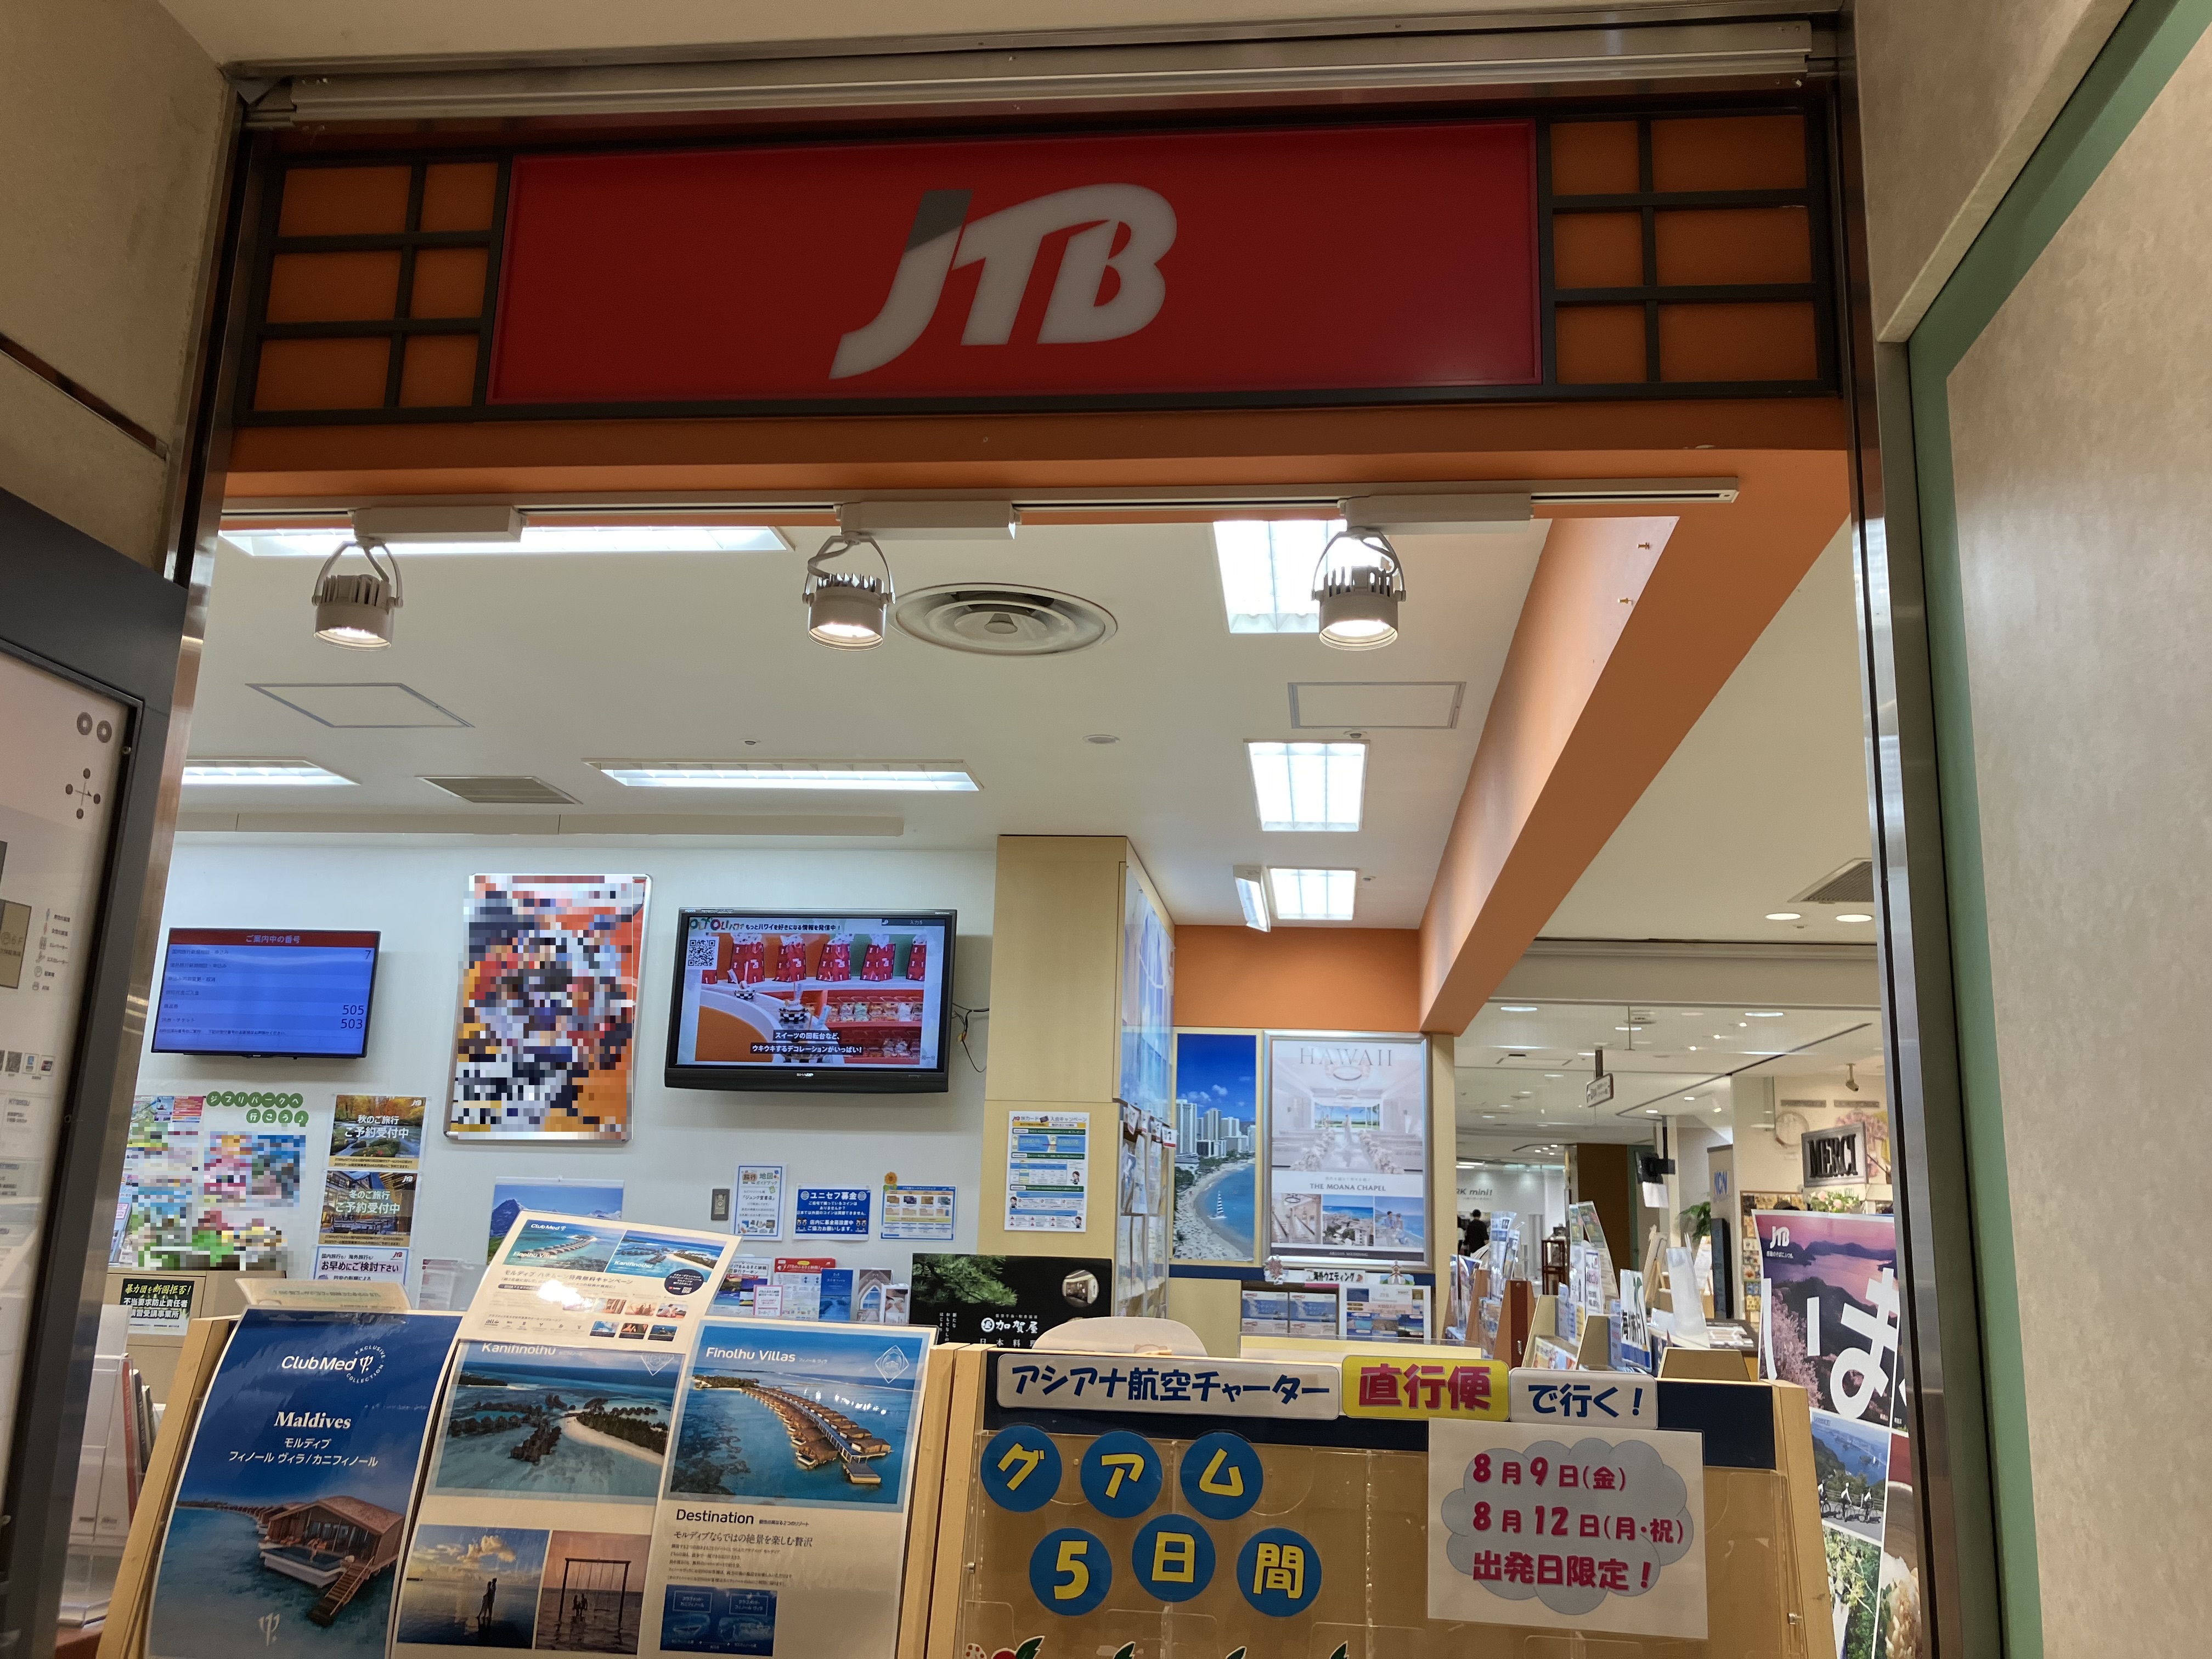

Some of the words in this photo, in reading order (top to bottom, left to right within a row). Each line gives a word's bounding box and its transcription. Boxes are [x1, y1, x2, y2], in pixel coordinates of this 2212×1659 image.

[829, 182, 1177, 380] JTB
[246, 935, 301, 944] ご案内中の番号
[365, 950, 371, 960] 7
[343, 1005, 364, 1015] 505
[341, 1018, 363, 1029] 503
[775, 1032, 840, 1040] スイーツの回転台など、
[752, 1045, 862, 1053] ウキウキするデコレーションがいっぱい！
[1300, 1047, 1392, 1066] HAWAII
[357, 1114, 400, 1125] 秋のご旅行
[345, 1126, 409, 1139] ご予約受付中
[1808, 1133, 1858, 1178] MERCI
[349, 1189, 391, 1200] 冬のご旅行
[810, 1192, 857, 1200] ユニセフ募金
[336, 1201, 400, 1214] ご予約受付中
[1769, 1226, 1790, 1249] JTB
[321, 1260, 399, 1272] お早めにご検討下さい
[614, 1260, 653, 1268] Kanifinolhu
[125, 1283, 191, 1295] 暴力団を断固拒否！
[123, 1297, 188, 1308] 不当要求防止責任者
[995, 1319, 1038, 1334] 加賀屋
[355, 1345, 386, 1359] EXCLUSIVE
[481, 1342, 556, 1356] Kanifinolhu
[706, 1347, 755, 1361] Finolhu
[759, 1350, 795, 1362] Villas
[281, 1355, 319, 1369] Club
[319, 1356, 358, 1371] Med
[346, 1364, 384, 1384] COLLECTION
[1012, 1365, 1330, 1405] アシアナ航空チャーター
[1358, 1363, 1492, 1412] 直行便
[1528, 1383, 1643, 1418] で行く！
[274, 1411, 352, 1430] Maldives
[284, 1437, 332, 1449] モルディブ
[229, 1451, 274, 1462] フィノール
[1473, 1452, 1626, 1492] 8月9日(金)
[676, 1509, 754, 1525] Destination
[1473, 1501, 1684, 1545] 8月12日(月・祝)
[674, 1530, 813, 1548] モルディブならではの絶景を楽しむ贅沢
[1053, 1530, 1306, 1601] 5日間
[1472, 1550, 1651, 1592] 出発日限定！
